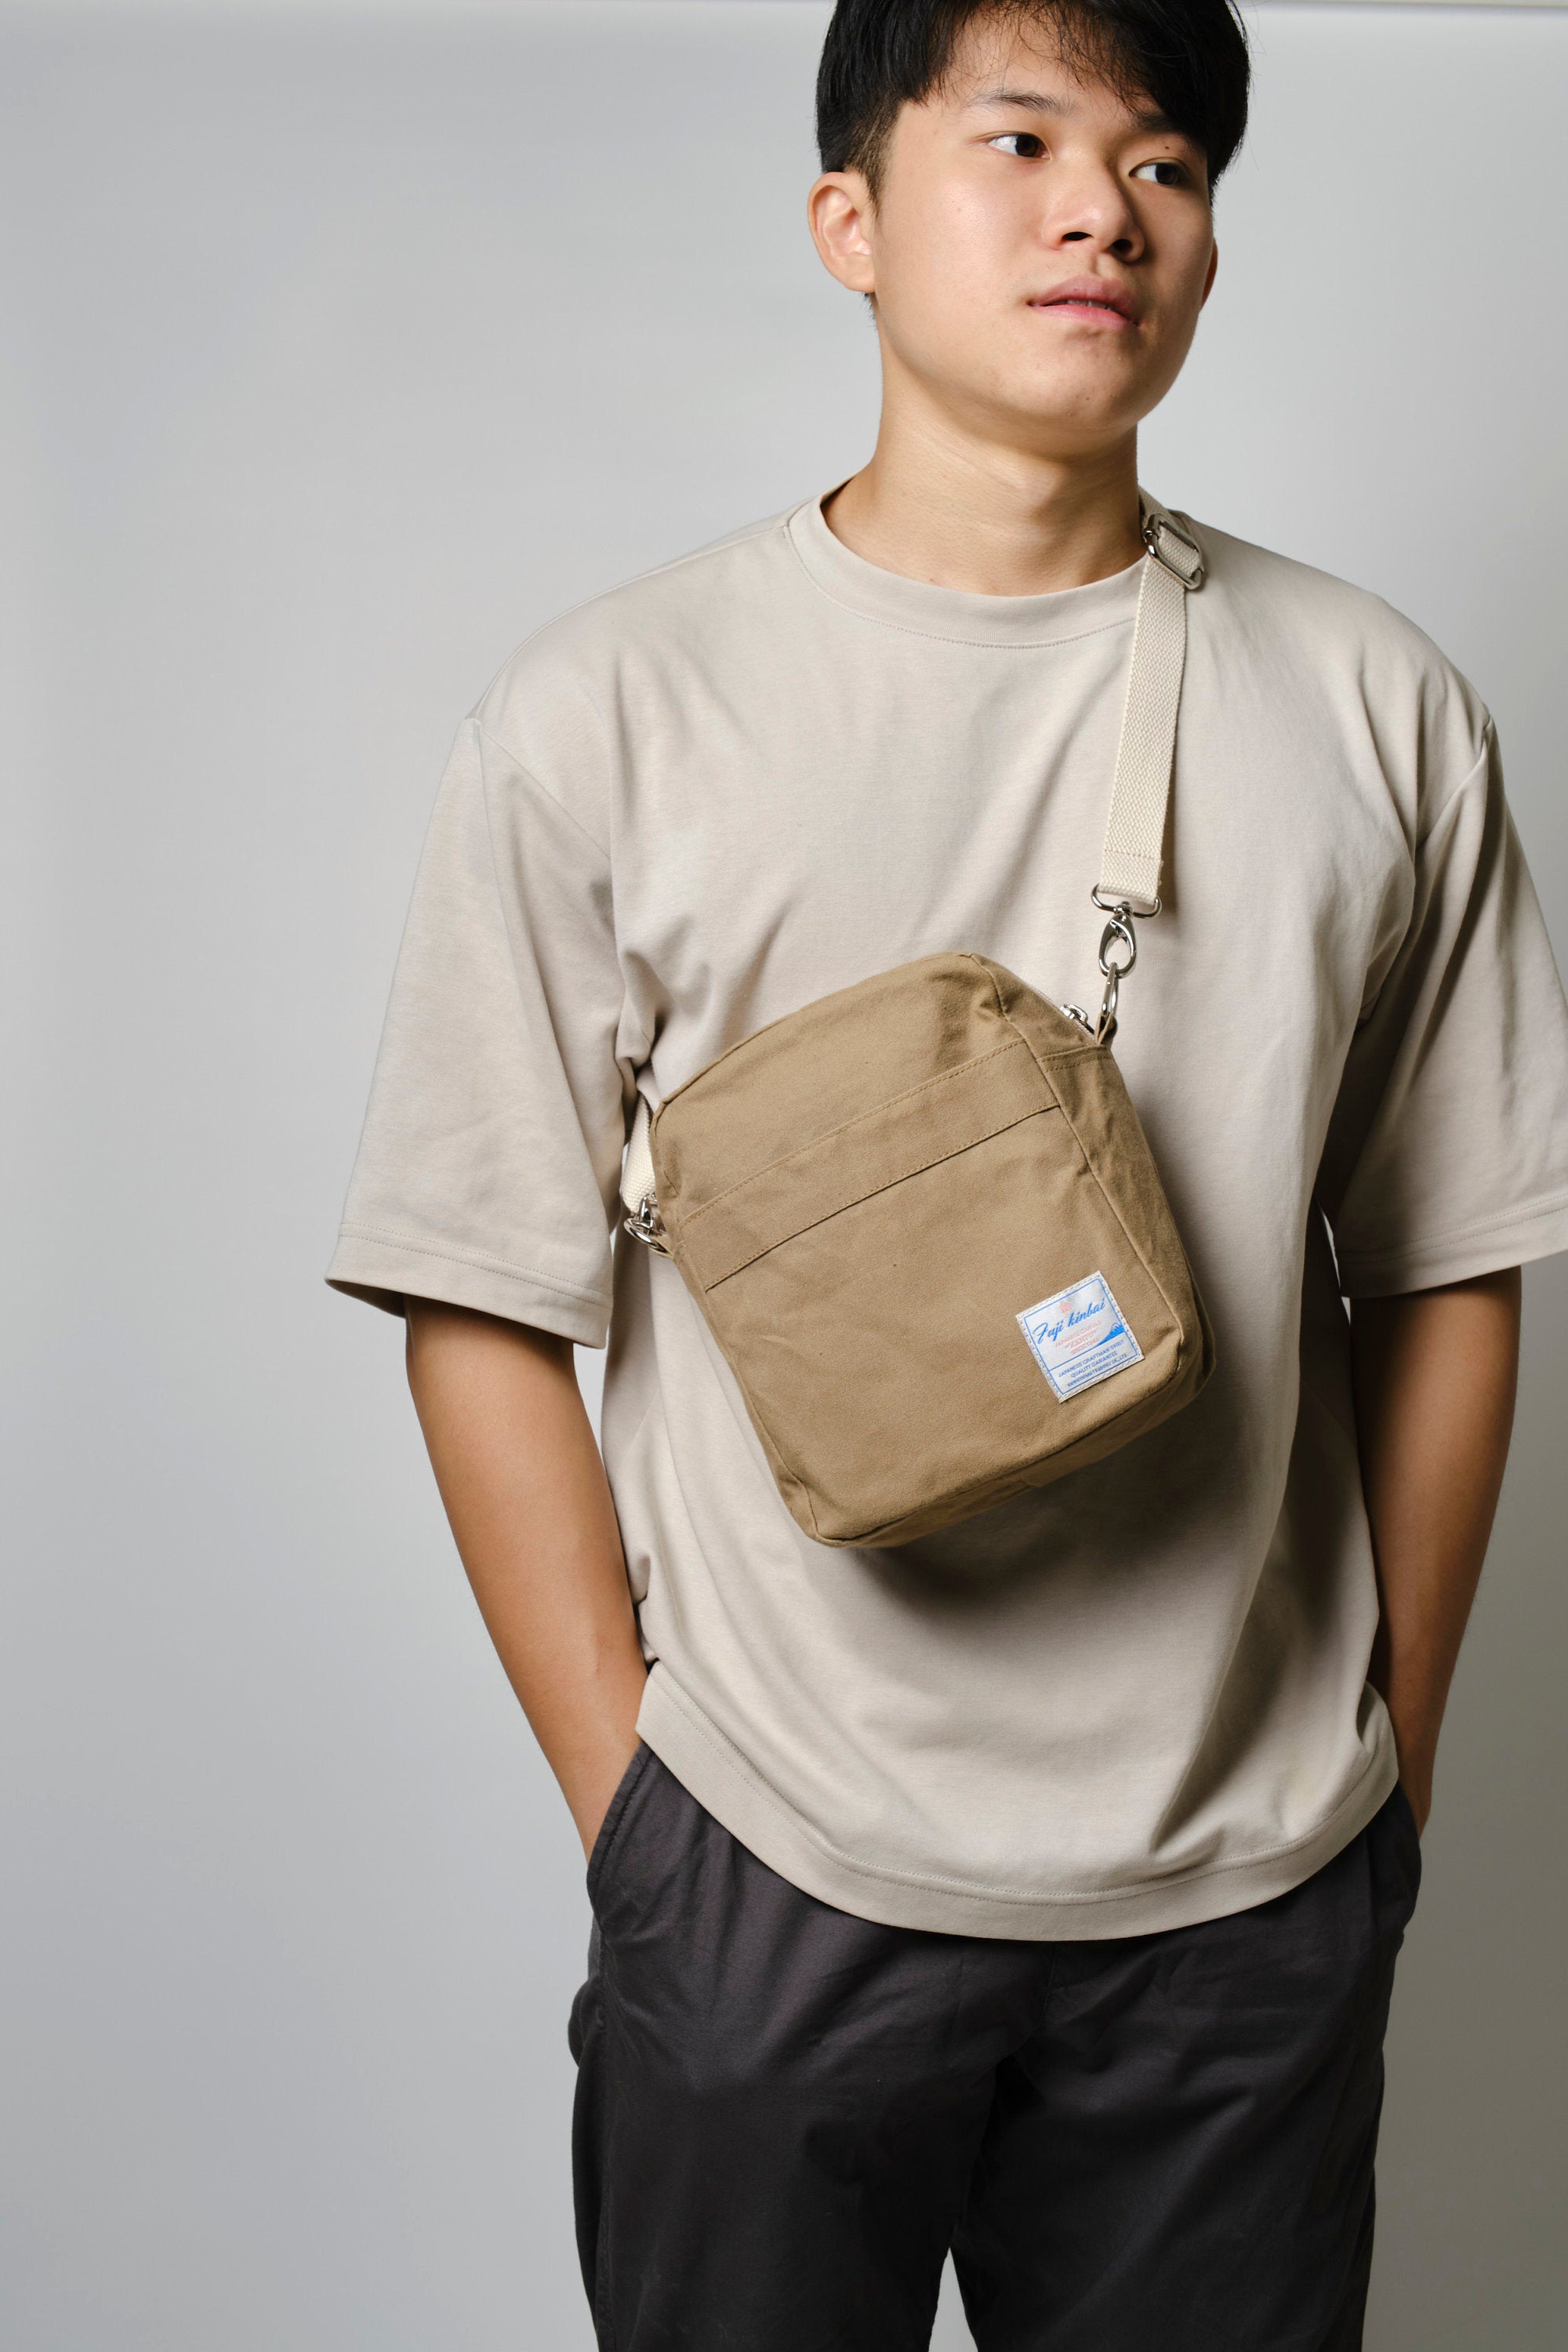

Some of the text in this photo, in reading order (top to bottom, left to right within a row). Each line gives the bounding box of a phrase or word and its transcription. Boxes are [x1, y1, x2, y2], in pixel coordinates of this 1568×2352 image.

[1033, 1298, 1105, 1344] Fuji kinbai
[1059, 1362, 1082, 1377] JAPANESE
[1071, 1364, 1091, 1378] QUALITY
